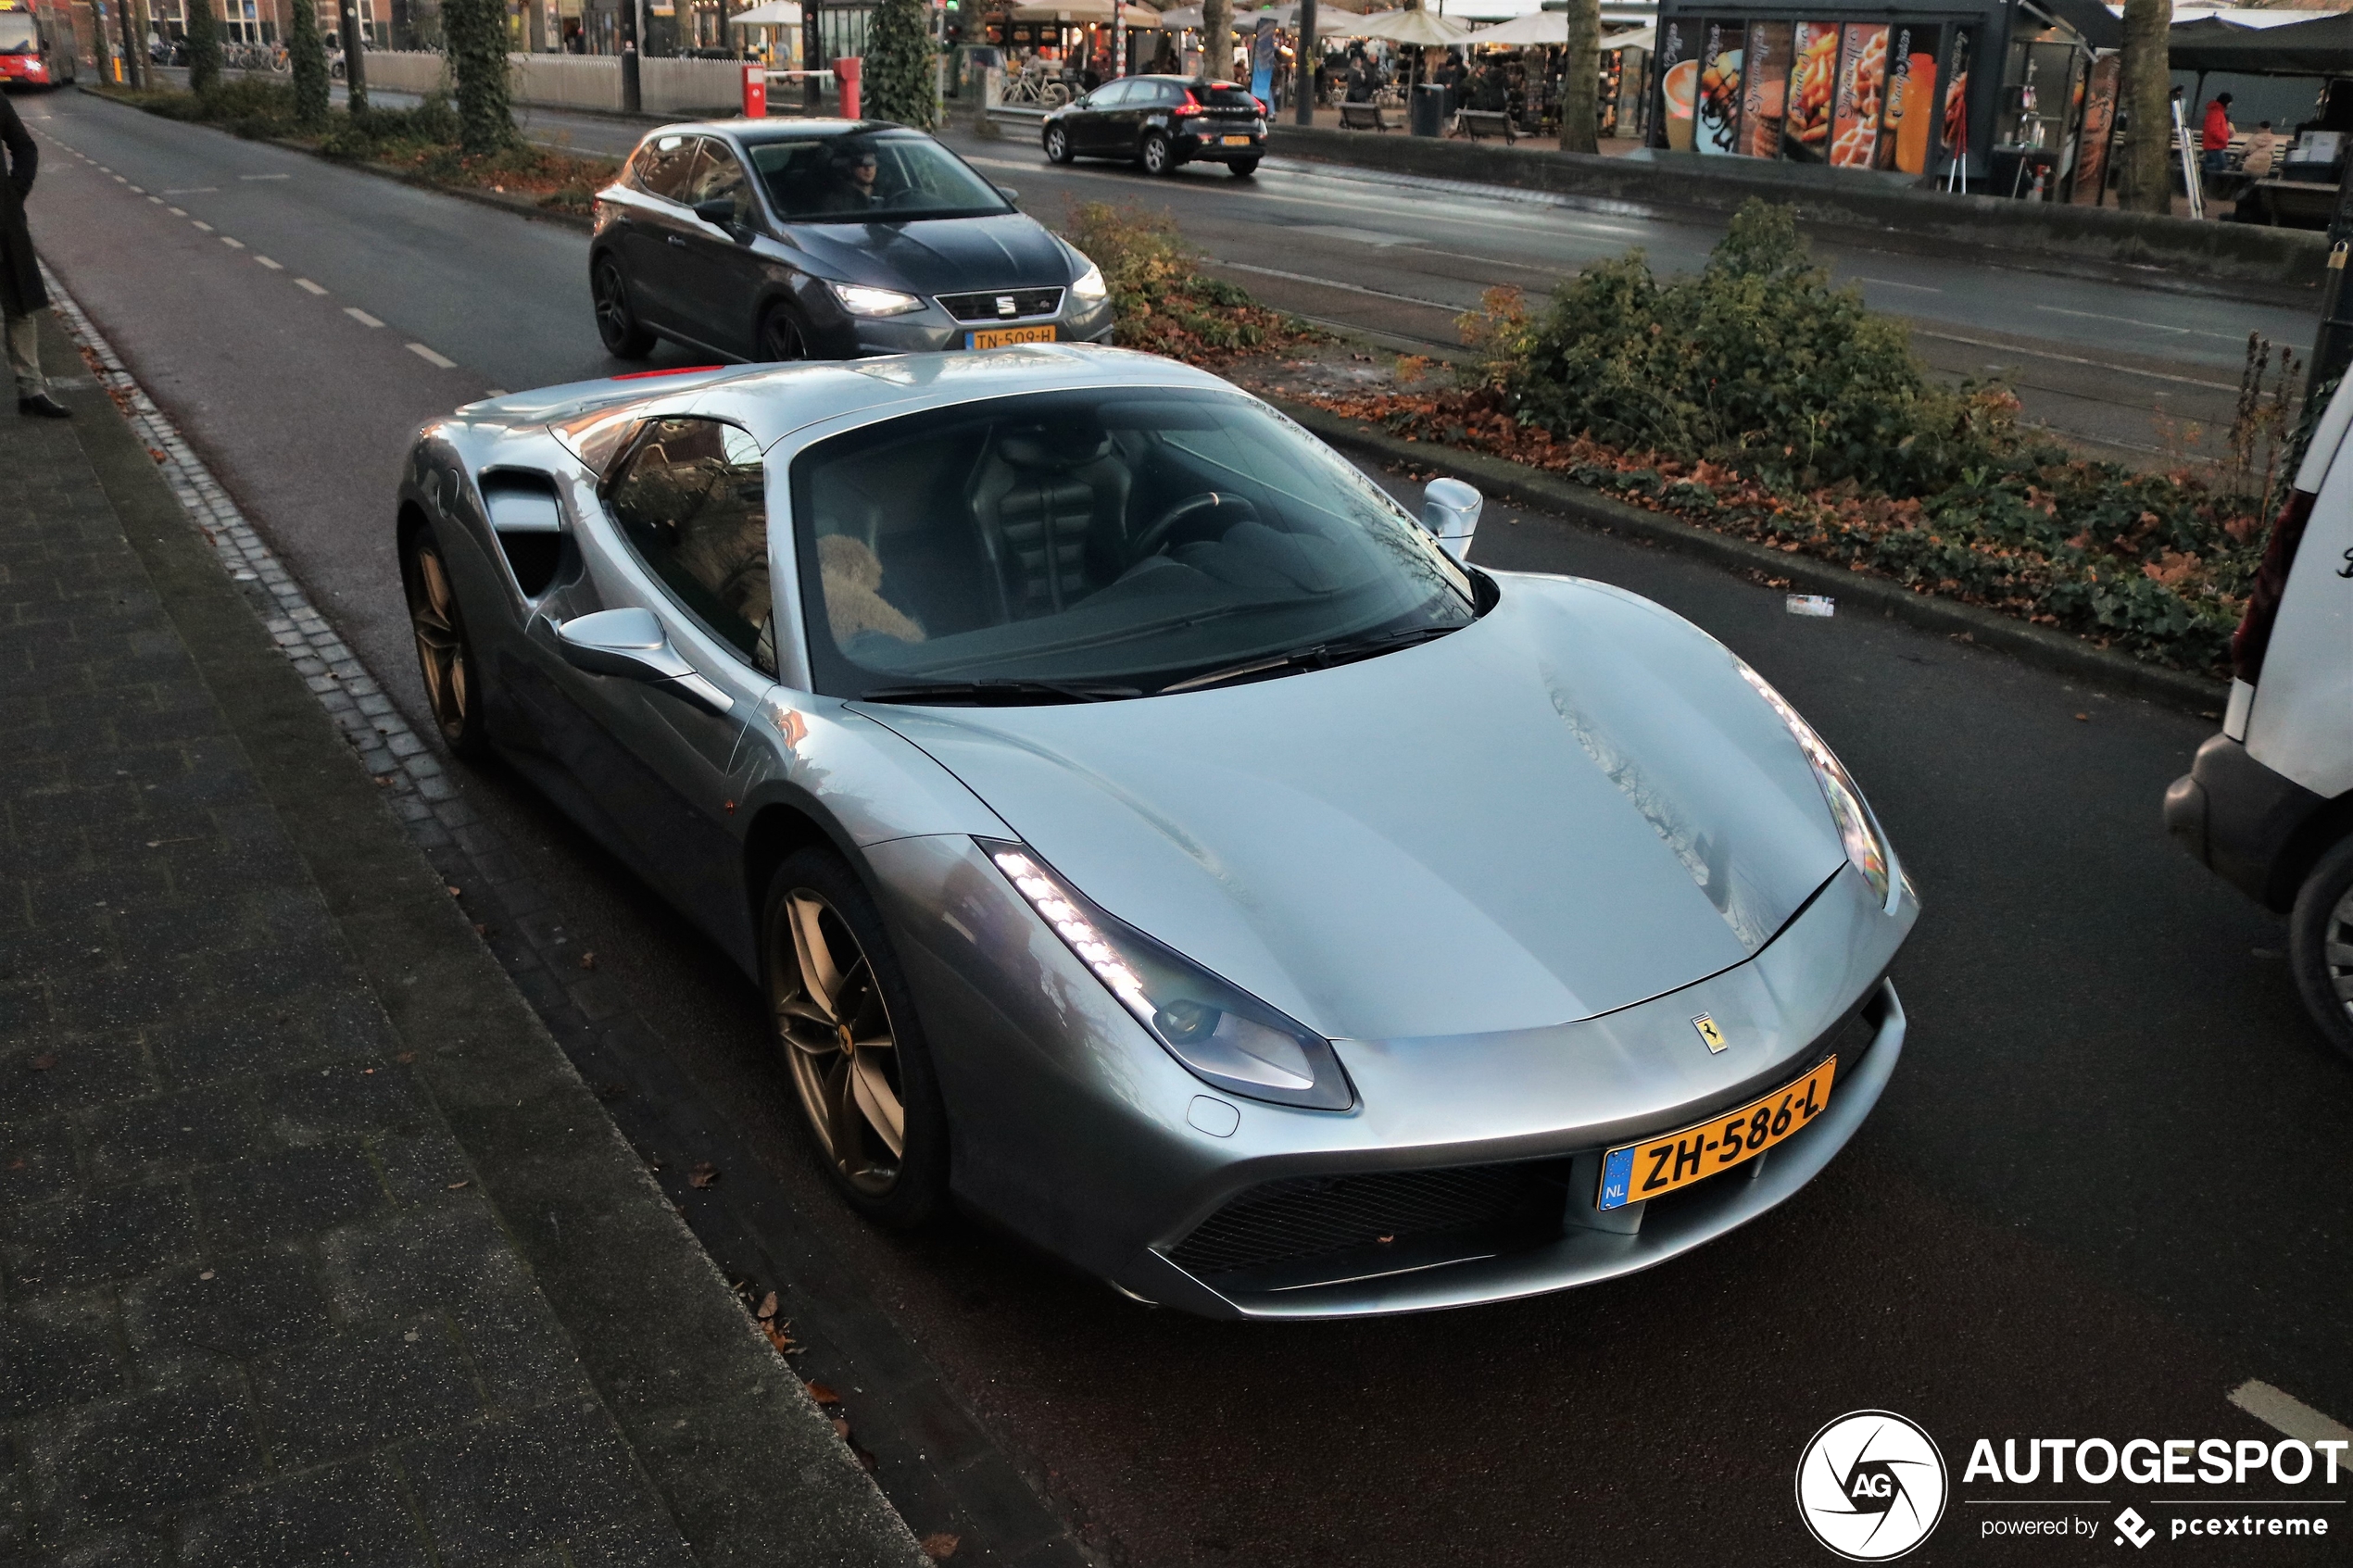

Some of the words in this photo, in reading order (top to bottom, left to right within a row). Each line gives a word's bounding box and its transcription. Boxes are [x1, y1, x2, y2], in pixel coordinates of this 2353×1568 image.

[1796, 28, 1811, 65] Fries
[1791, 69, 1806, 119] French
[977, 329, 1051, 349] TN-509-H
[1642, 1079, 1818, 1192] ZH-586-L
[1605, 1184, 1624, 1199] NL
